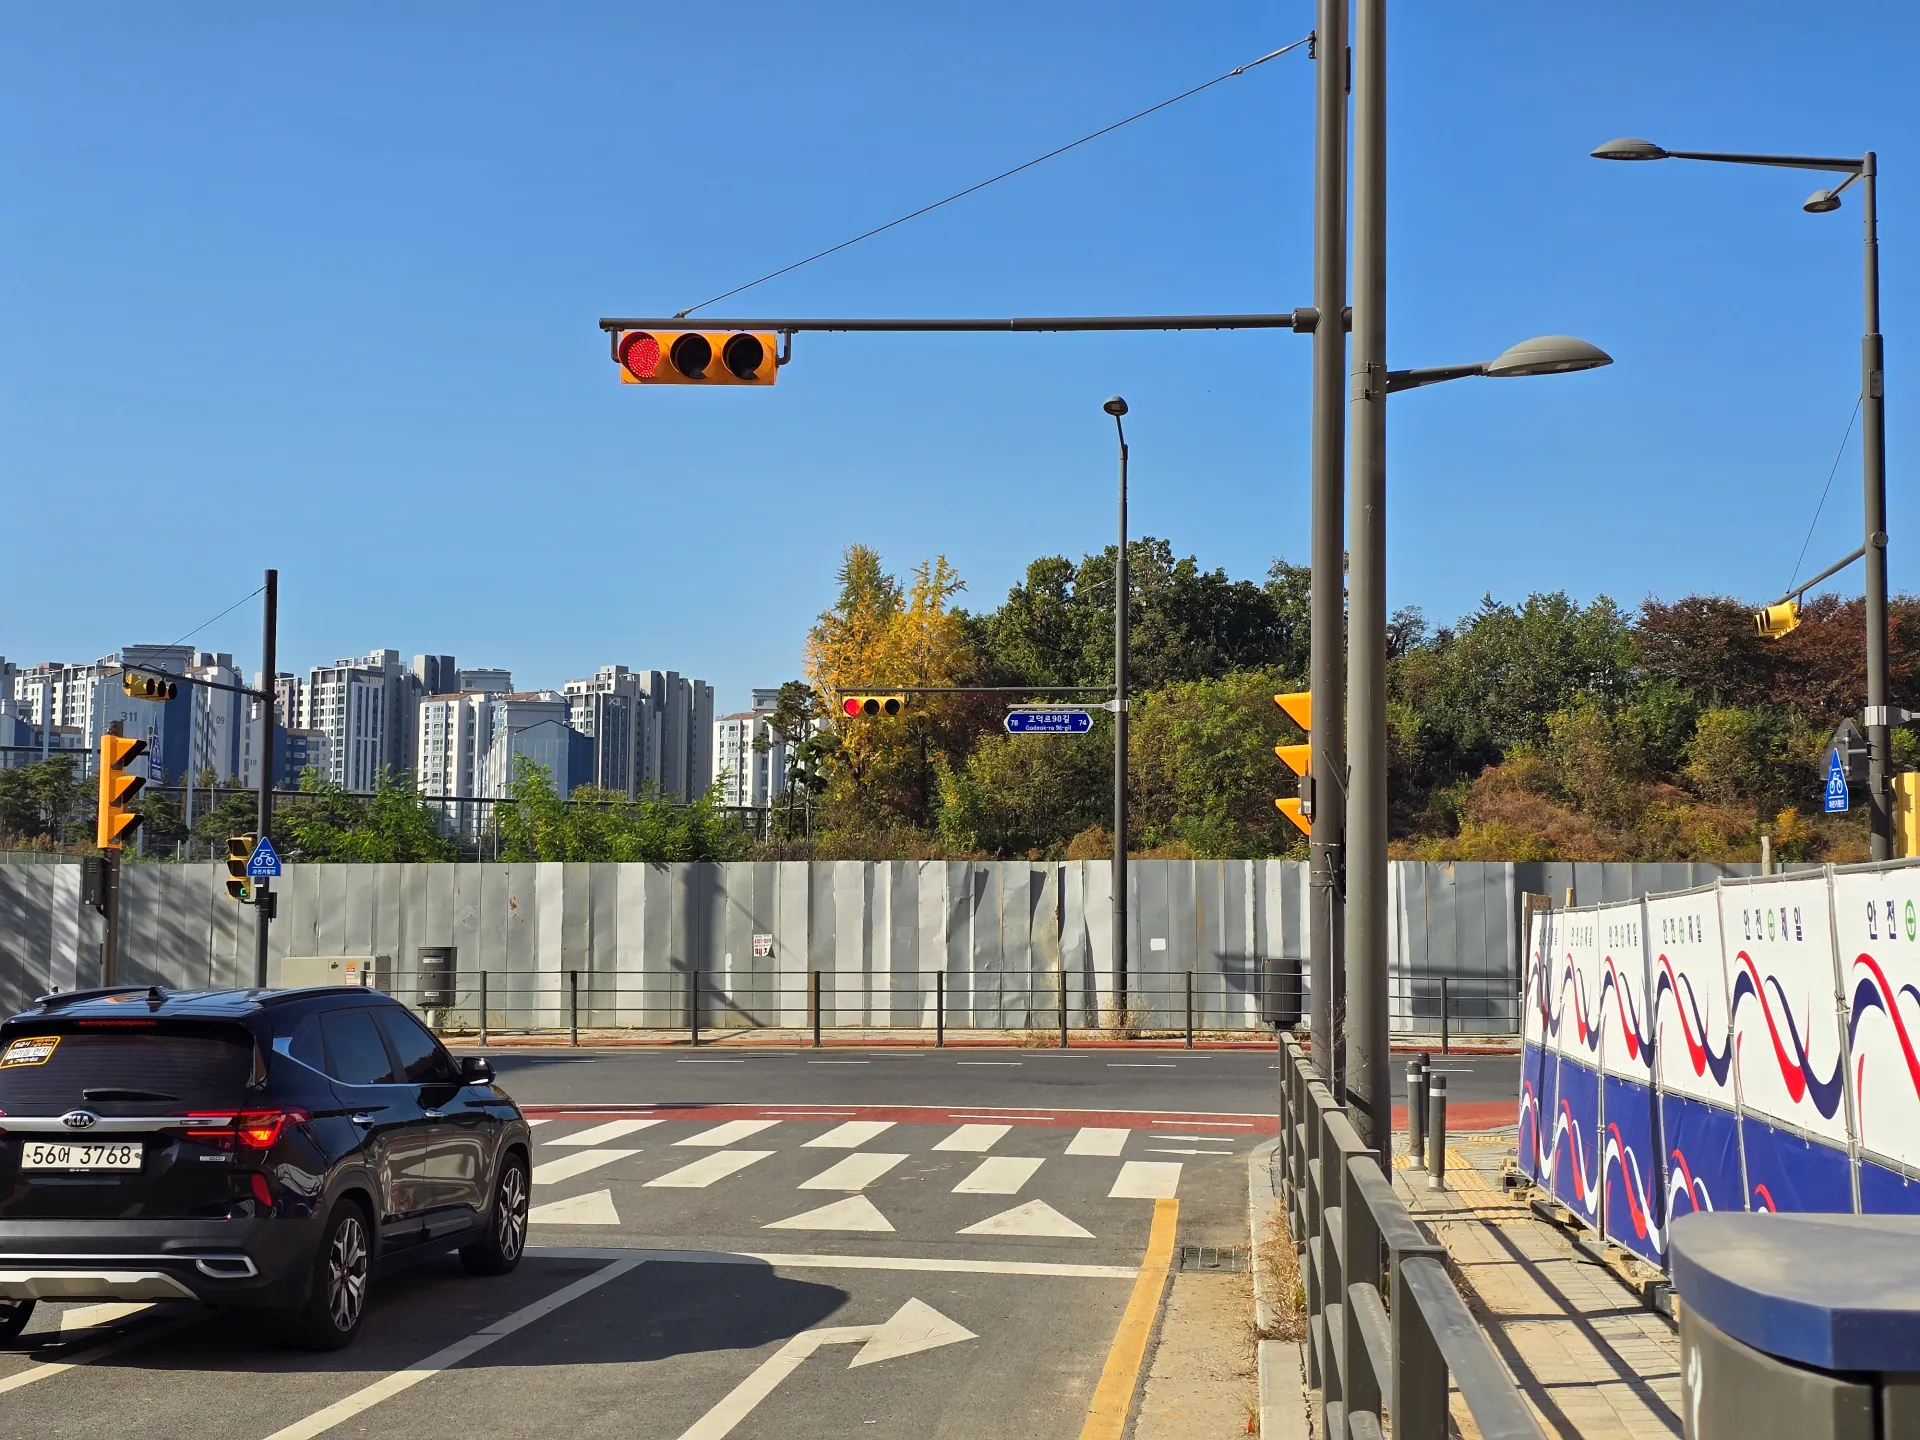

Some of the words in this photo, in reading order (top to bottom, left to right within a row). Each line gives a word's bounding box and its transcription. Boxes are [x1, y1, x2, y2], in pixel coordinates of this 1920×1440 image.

[120, 712, 138, 722] 311
[1027, 714, 1070, 724] 고덕로98길
[1743, 908, 1763, 941] 안전
[1780, 906, 1803, 942] 제일
[1867, 899, 1897, 941] 안전
[32, 1046, 50, 1055] 먼저
[67, 1115, 90, 1126] KIA
[32, 1145, 70, 1165] 56어
[80, 1145, 131, 1165] 3768
